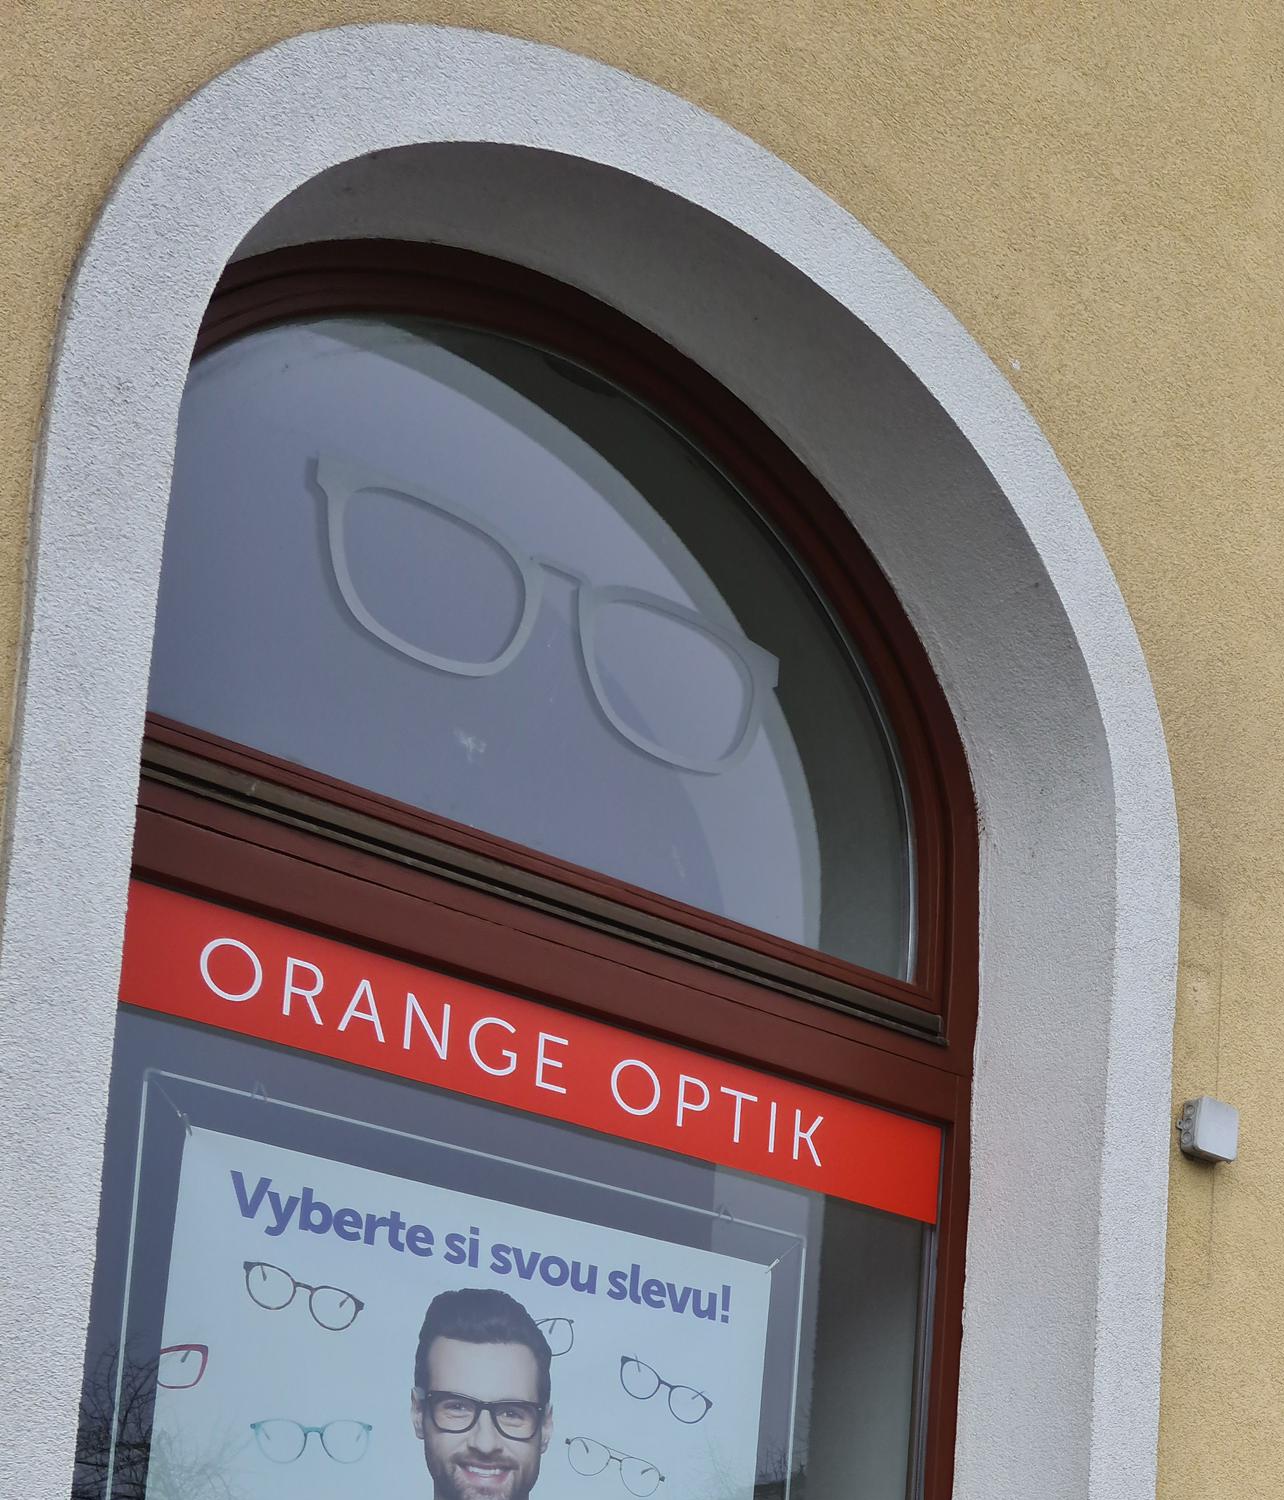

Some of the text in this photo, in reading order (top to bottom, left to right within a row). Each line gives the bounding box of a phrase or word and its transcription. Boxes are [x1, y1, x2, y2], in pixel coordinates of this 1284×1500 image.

[199, 937, 825, 1167] ORANGE OPTIK
[230, 1170, 731, 1323] Vyberte si svou slevu!
